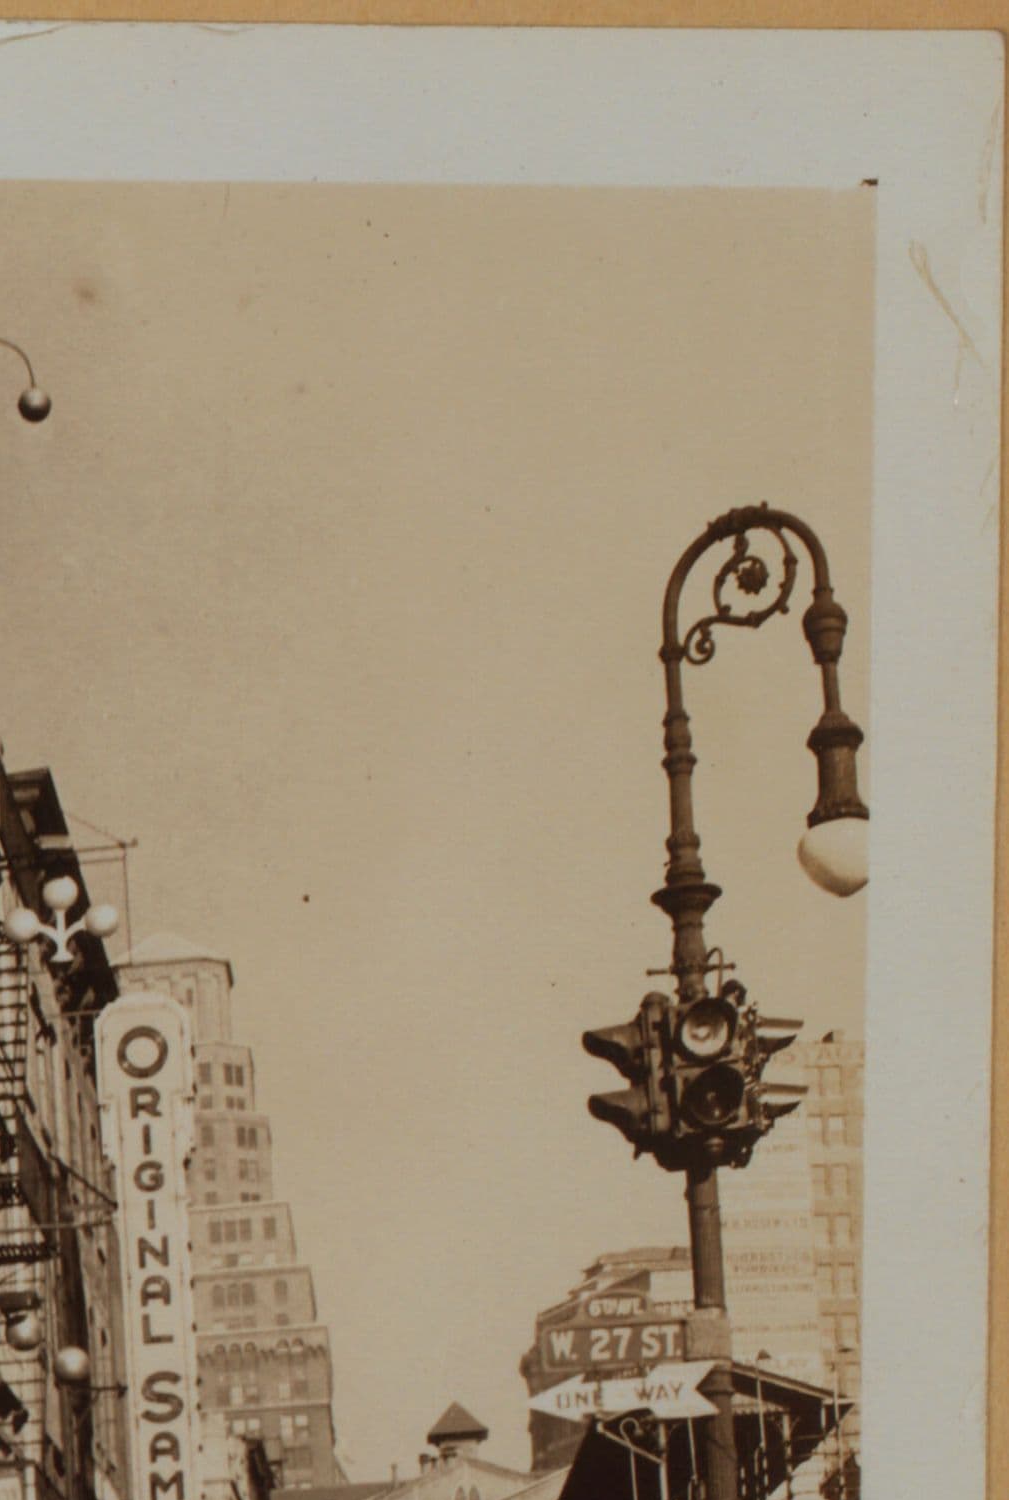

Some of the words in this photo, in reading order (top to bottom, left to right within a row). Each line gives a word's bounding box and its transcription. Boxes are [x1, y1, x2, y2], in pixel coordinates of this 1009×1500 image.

[117, 1025, 174, 1344] ORIGINAL
[549, 1330, 578, 1361] W.
[589, 1328, 632, 1361] 27
[641, 1323, 682, 1358] ST.
[555, 1385, 604, 1410] ONE
[634, 1381, 687, 1402] WAY
